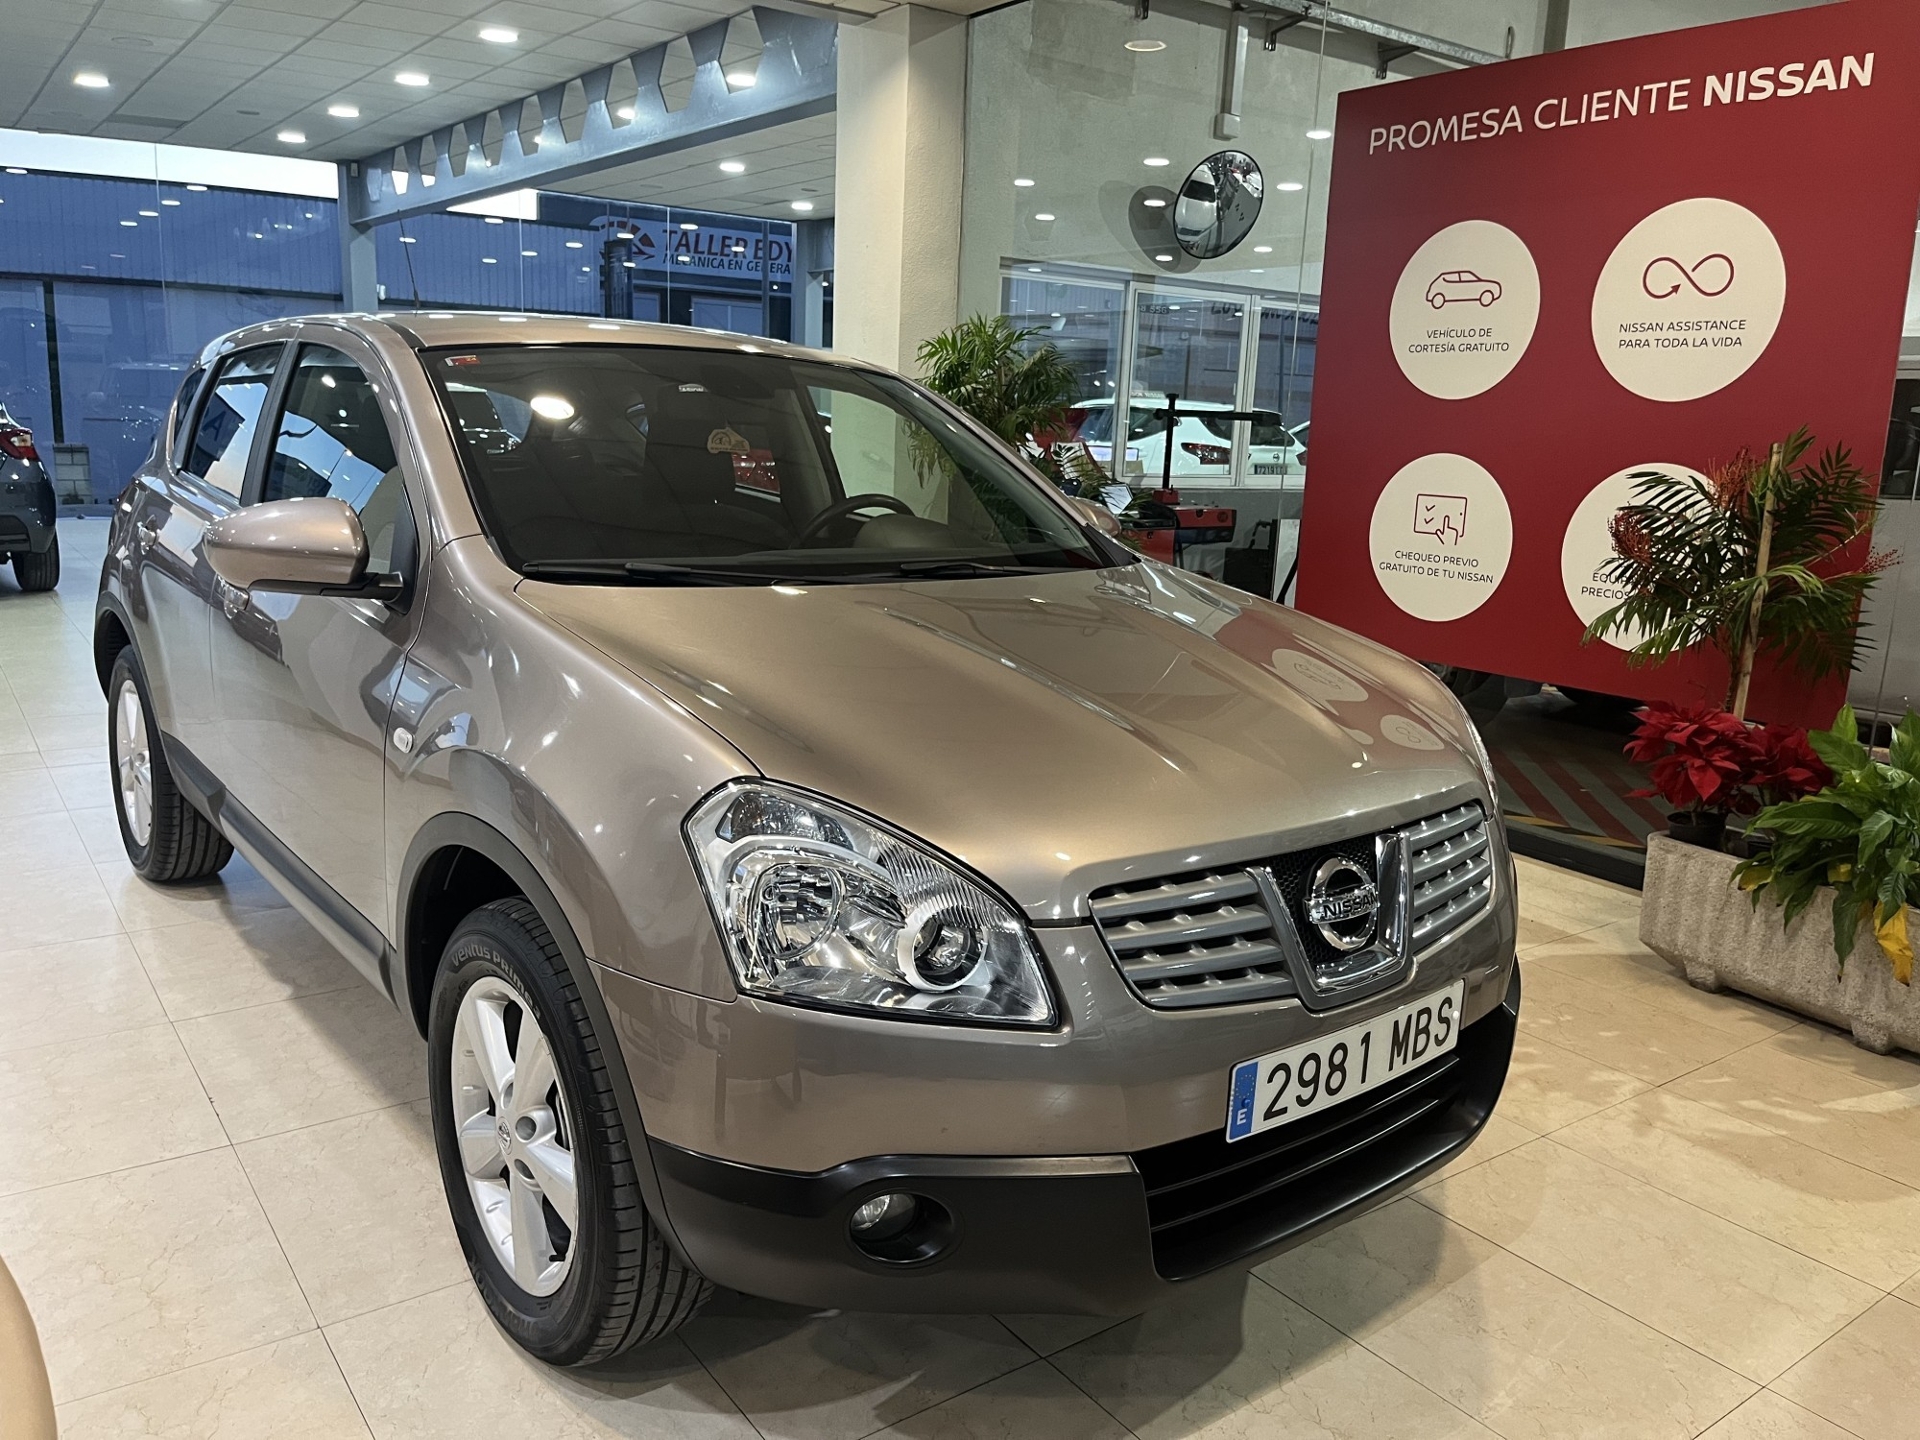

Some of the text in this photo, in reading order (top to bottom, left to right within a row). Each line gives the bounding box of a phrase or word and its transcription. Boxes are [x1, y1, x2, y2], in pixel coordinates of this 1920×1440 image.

[1369, 52, 1875, 155] PROMESA CLIENTE NISSAN
[662, 229, 748, 260] TALLER
[727, 260, 743, 271] EN
[747, 260, 791, 275] GEERA
[1426, 327, 1493, 339] VEHÍCULO DE
[1619, 319, 1746, 333] NISSAN ASSISTANCE
[1408, 341, 1510, 354] CORTESÍA GRATUITO
[1619, 336, 1743, 349] PARA TODA LA VIDA
[1394, 550, 1479, 568] CHEQUEO PREVIO
[1379, 561, 1494, 584] GRATUITO DE TU NISSAN
[1323, 892, 1378, 918] NISSAN
[1263, 996, 1453, 1122] 2981 MBS
[1236, 1108, 1248, 1126] E
